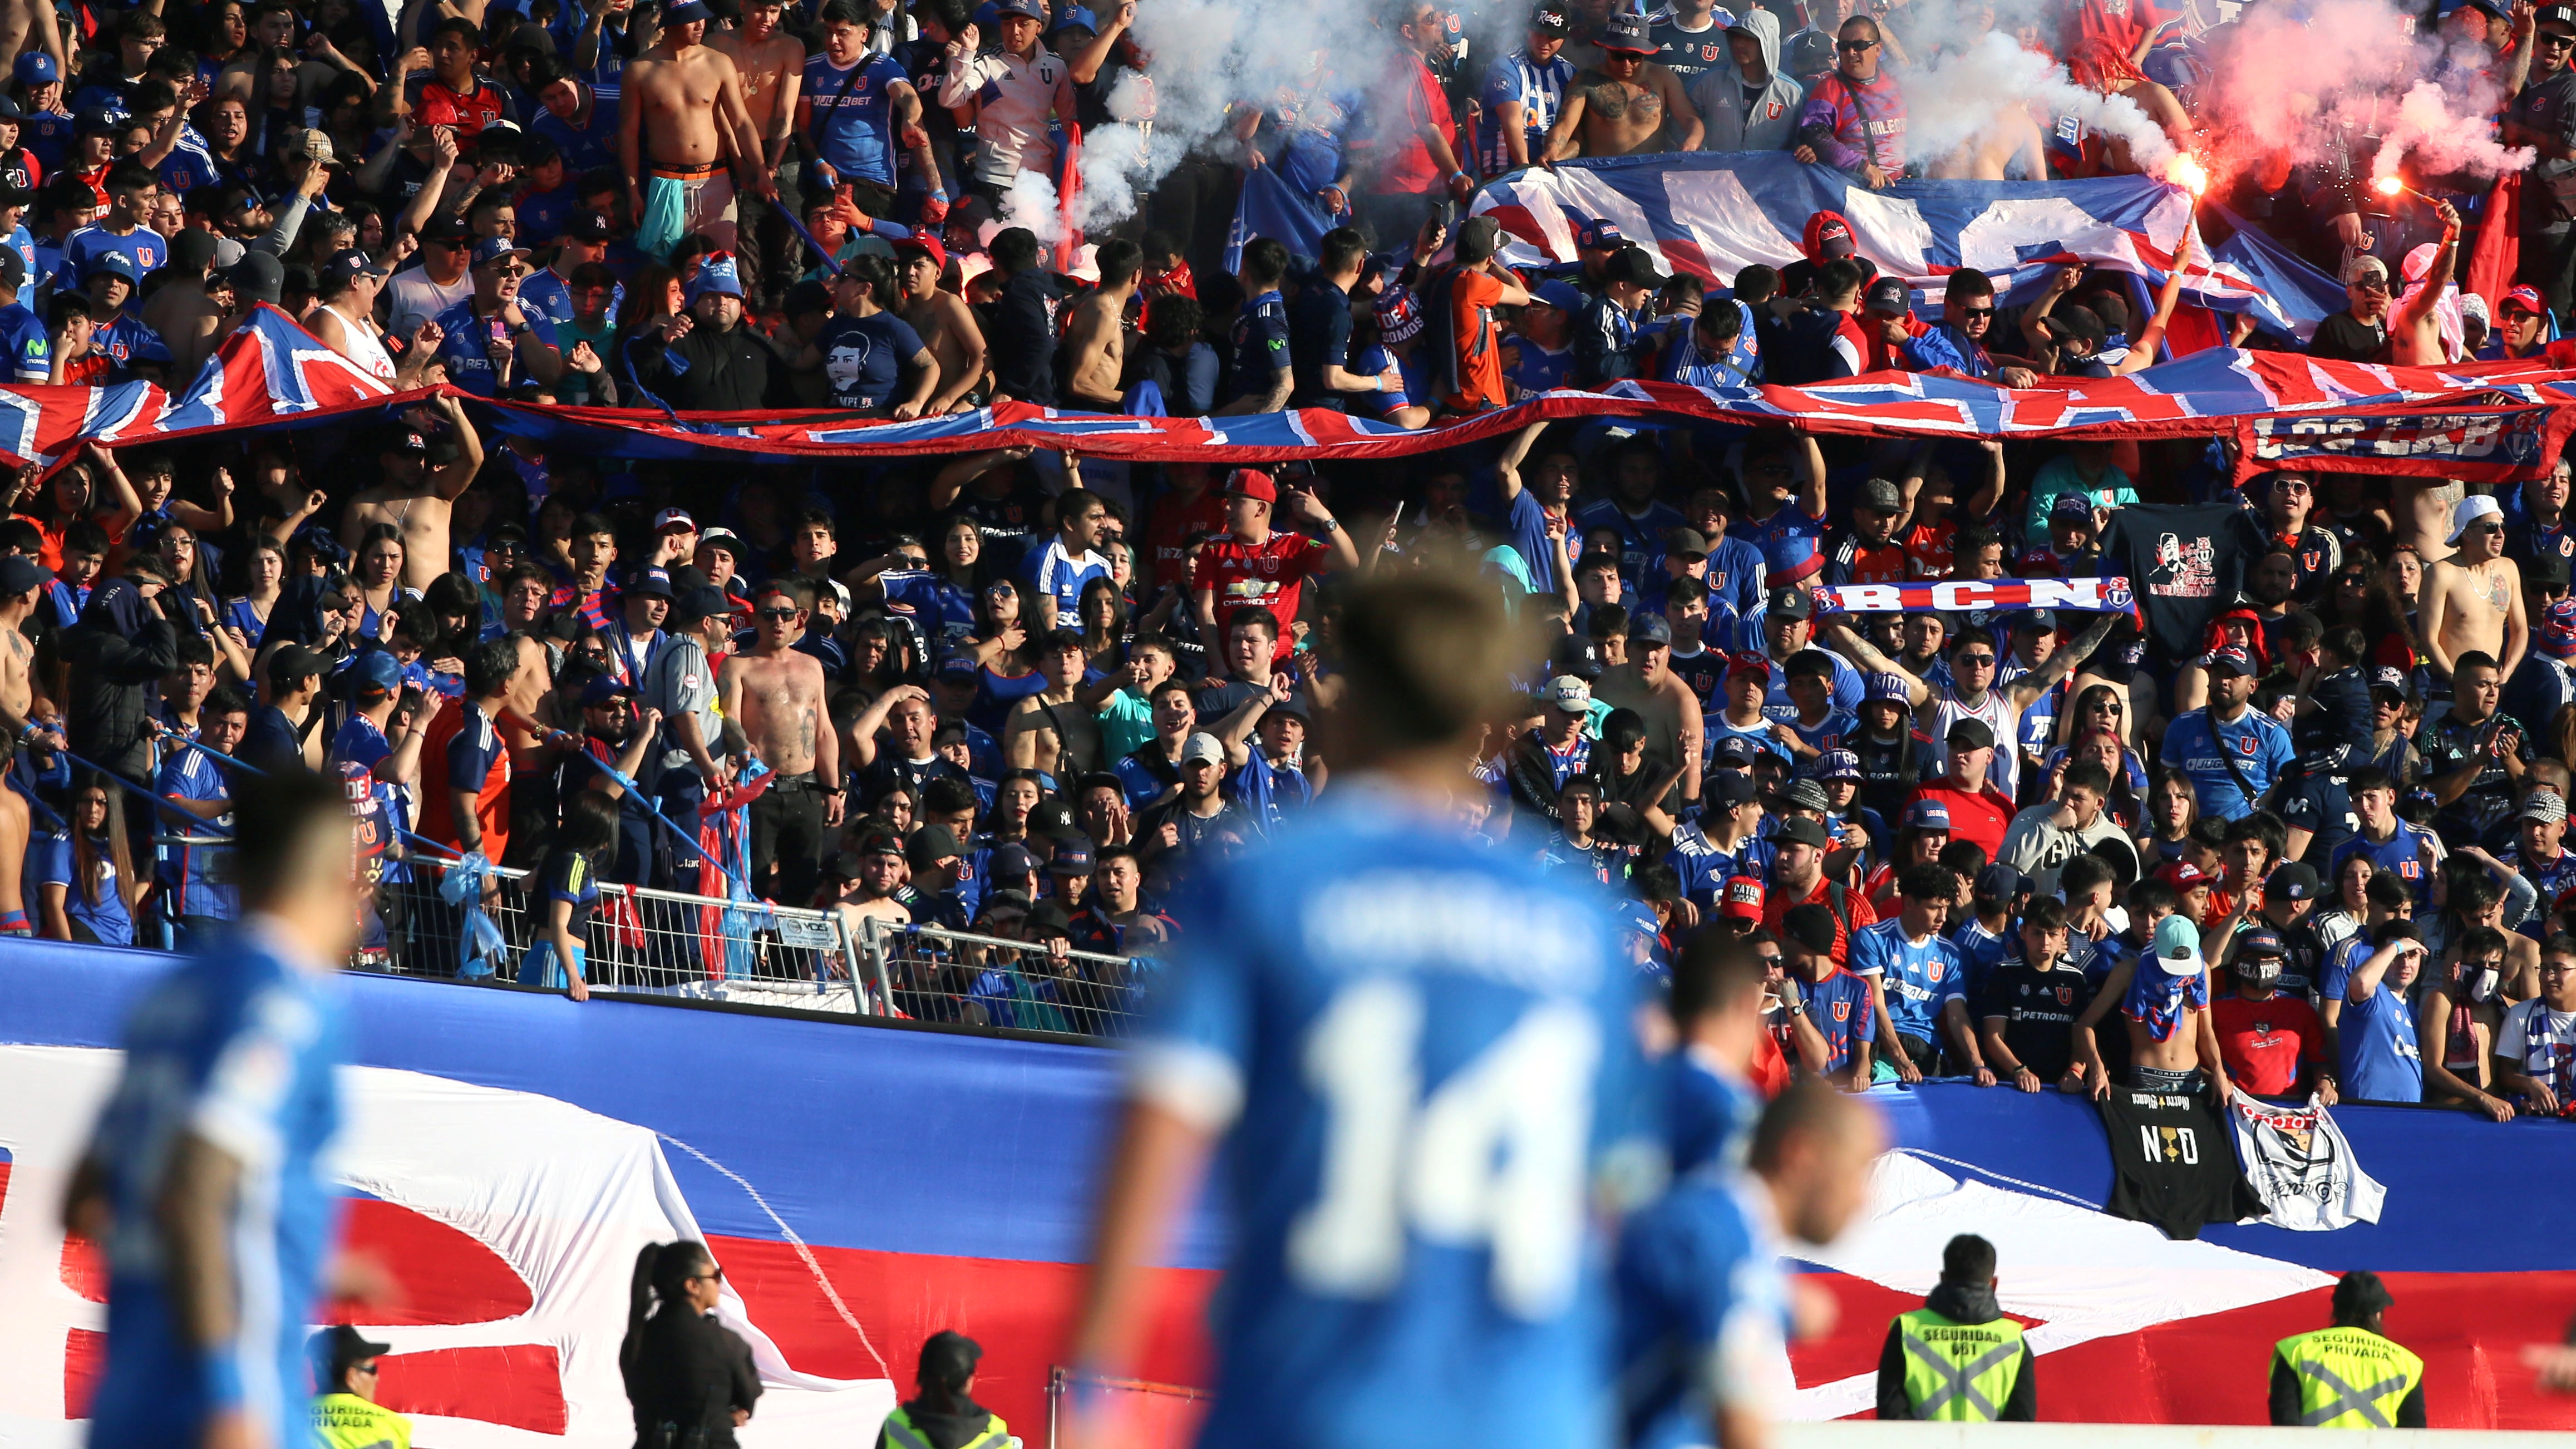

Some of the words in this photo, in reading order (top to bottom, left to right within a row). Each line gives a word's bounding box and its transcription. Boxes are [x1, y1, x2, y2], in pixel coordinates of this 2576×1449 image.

[1445, 14, 1461, 33] U
[1538, 11, 1564, 27] Reds
[1702, 45, 1719, 61] U
[855, 76, 868, 91] U
[1041, 68, 1052, 85] U
[821, 96, 871, 106] JUABET
[481, 111, 496, 125] U
[1766, 101, 1783, 120] U
[174, 171, 189, 188] U
[597, 215, 606, 229] NY
[1582, 231, 1592, 244] U
[2361, 232, 2375, 250] U
[21, 245, 34, 264] U
[137, 248, 154, 267] U
[349, 256, 361, 268] U
[1383, 307, 1400, 329] DE
[1382, 317, 1424, 344] SOMOS
[112, 344, 129, 360] U
[1744, 336, 1759, 357] U
[2254, 417, 2365, 459] LOS
[2373, 415, 2503, 456] LKB
[2102, 489, 2114, 504] U
[668, 509, 680, 518] U
[1006, 506, 1022, 522] U
[1570, 539, 1579, 560] U
[2559, 535, 2576, 558] U
[1263, 555, 1278, 573] U
[2200, 550, 2210, 561] U
[2303, 551, 2321, 571] U
[1709, 571, 1726, 590] U
[1223, 597, 1280, 607] CHEVROLET
[2112, 591, 2128, 605] U
[731, 614, 746, 629] U
[1586, 645, 1595, 661] NY
[1696, 674, 1713, 692] U
[1823, 734, 1839, 751] U
[2240, 736, 2258, 756] U
[346, 781, 366, 800] DE
[1060, 811, 1071, 827] NY
[2113, 811, 2128, 829] U
[359, 820, 377, 844] U
[957, 864, 973, 881] U
[1747, 861, 1763, 881] U
[2400, 861, 2418, 879] U
[1734, 884, 1760, 898] CATEN
[1927, 961, 1945, 982] U
[2056, 987, 2073, 1006] U
[1833, 1001, 1851, 1022] U
[1285, 977, 1603, 1327] 14
[2324, 1344, 2390, 1361] PRIVADA
[311, 1418, 373, 1429] RIVADA
